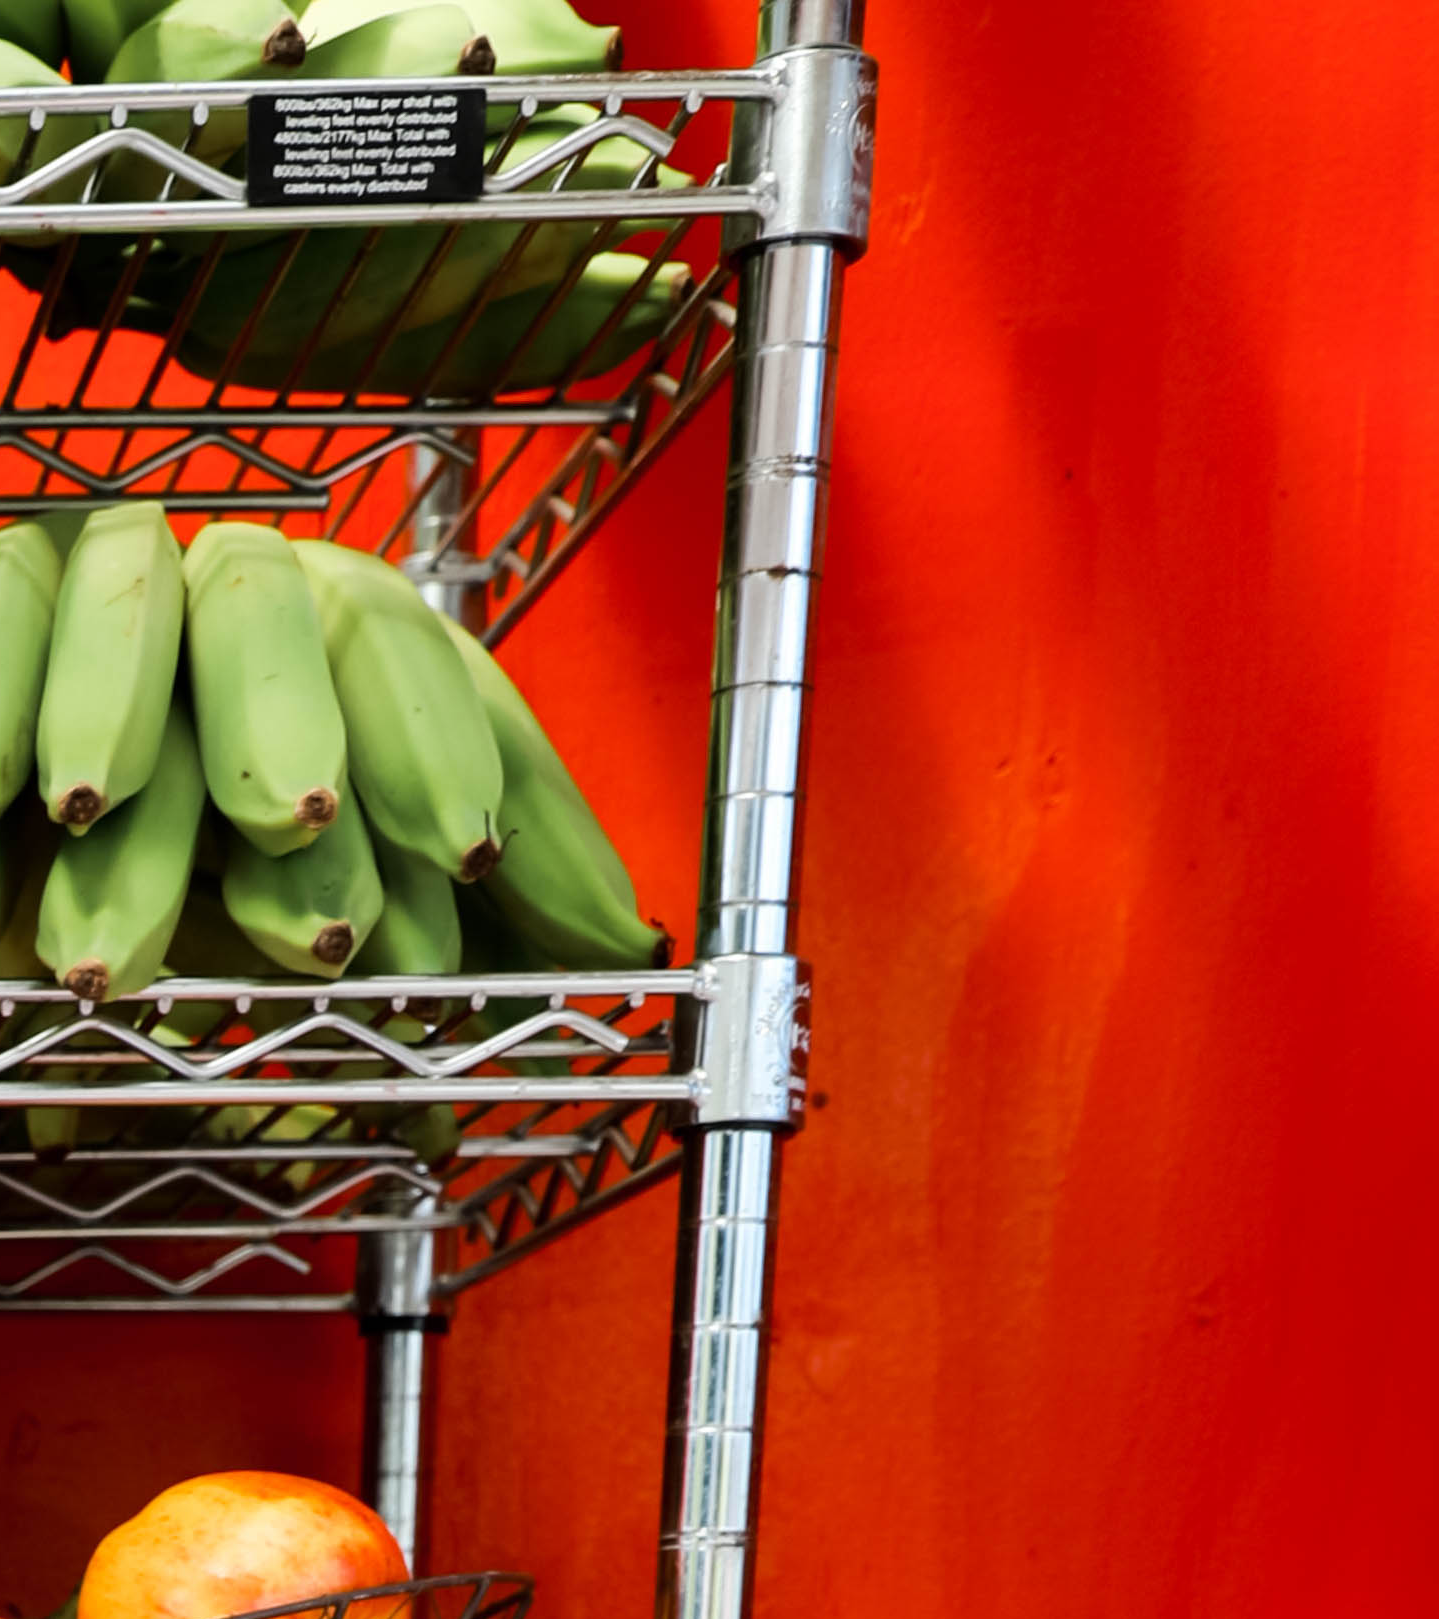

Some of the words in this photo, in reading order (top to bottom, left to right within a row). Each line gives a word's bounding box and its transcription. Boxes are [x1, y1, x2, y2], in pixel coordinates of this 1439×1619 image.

[353, 96, 379, 109] Max
[381, 98, 402, 112] per
[403, 95, 432, 109] shelf
[433, 95, 457, 108] with
[285, 114, 331, 130] leveling
[332, 113, 355, 127] feet
[356, 112, 395, 128] evenly
[396, 111, 457, 126] distributed
[367, 129, 393, 142] Max
[395, 128, 425, 142] Total
[425, 128, 450, 140] with
[285, 148, 330, 163] leveling
[331, 147, 354, 159] feet
[355, 146, 394, 161] evenly
[395, 143, 456, 158] distributed
[351, 162, 377, 176] Max
[380, 161, 409, 176] Total
[411, 161, 435, 174] with
[283, 181, 326, 195] casters
[327, 180, 366, 197] evenly
[366, 178, 428, 194] distributed
